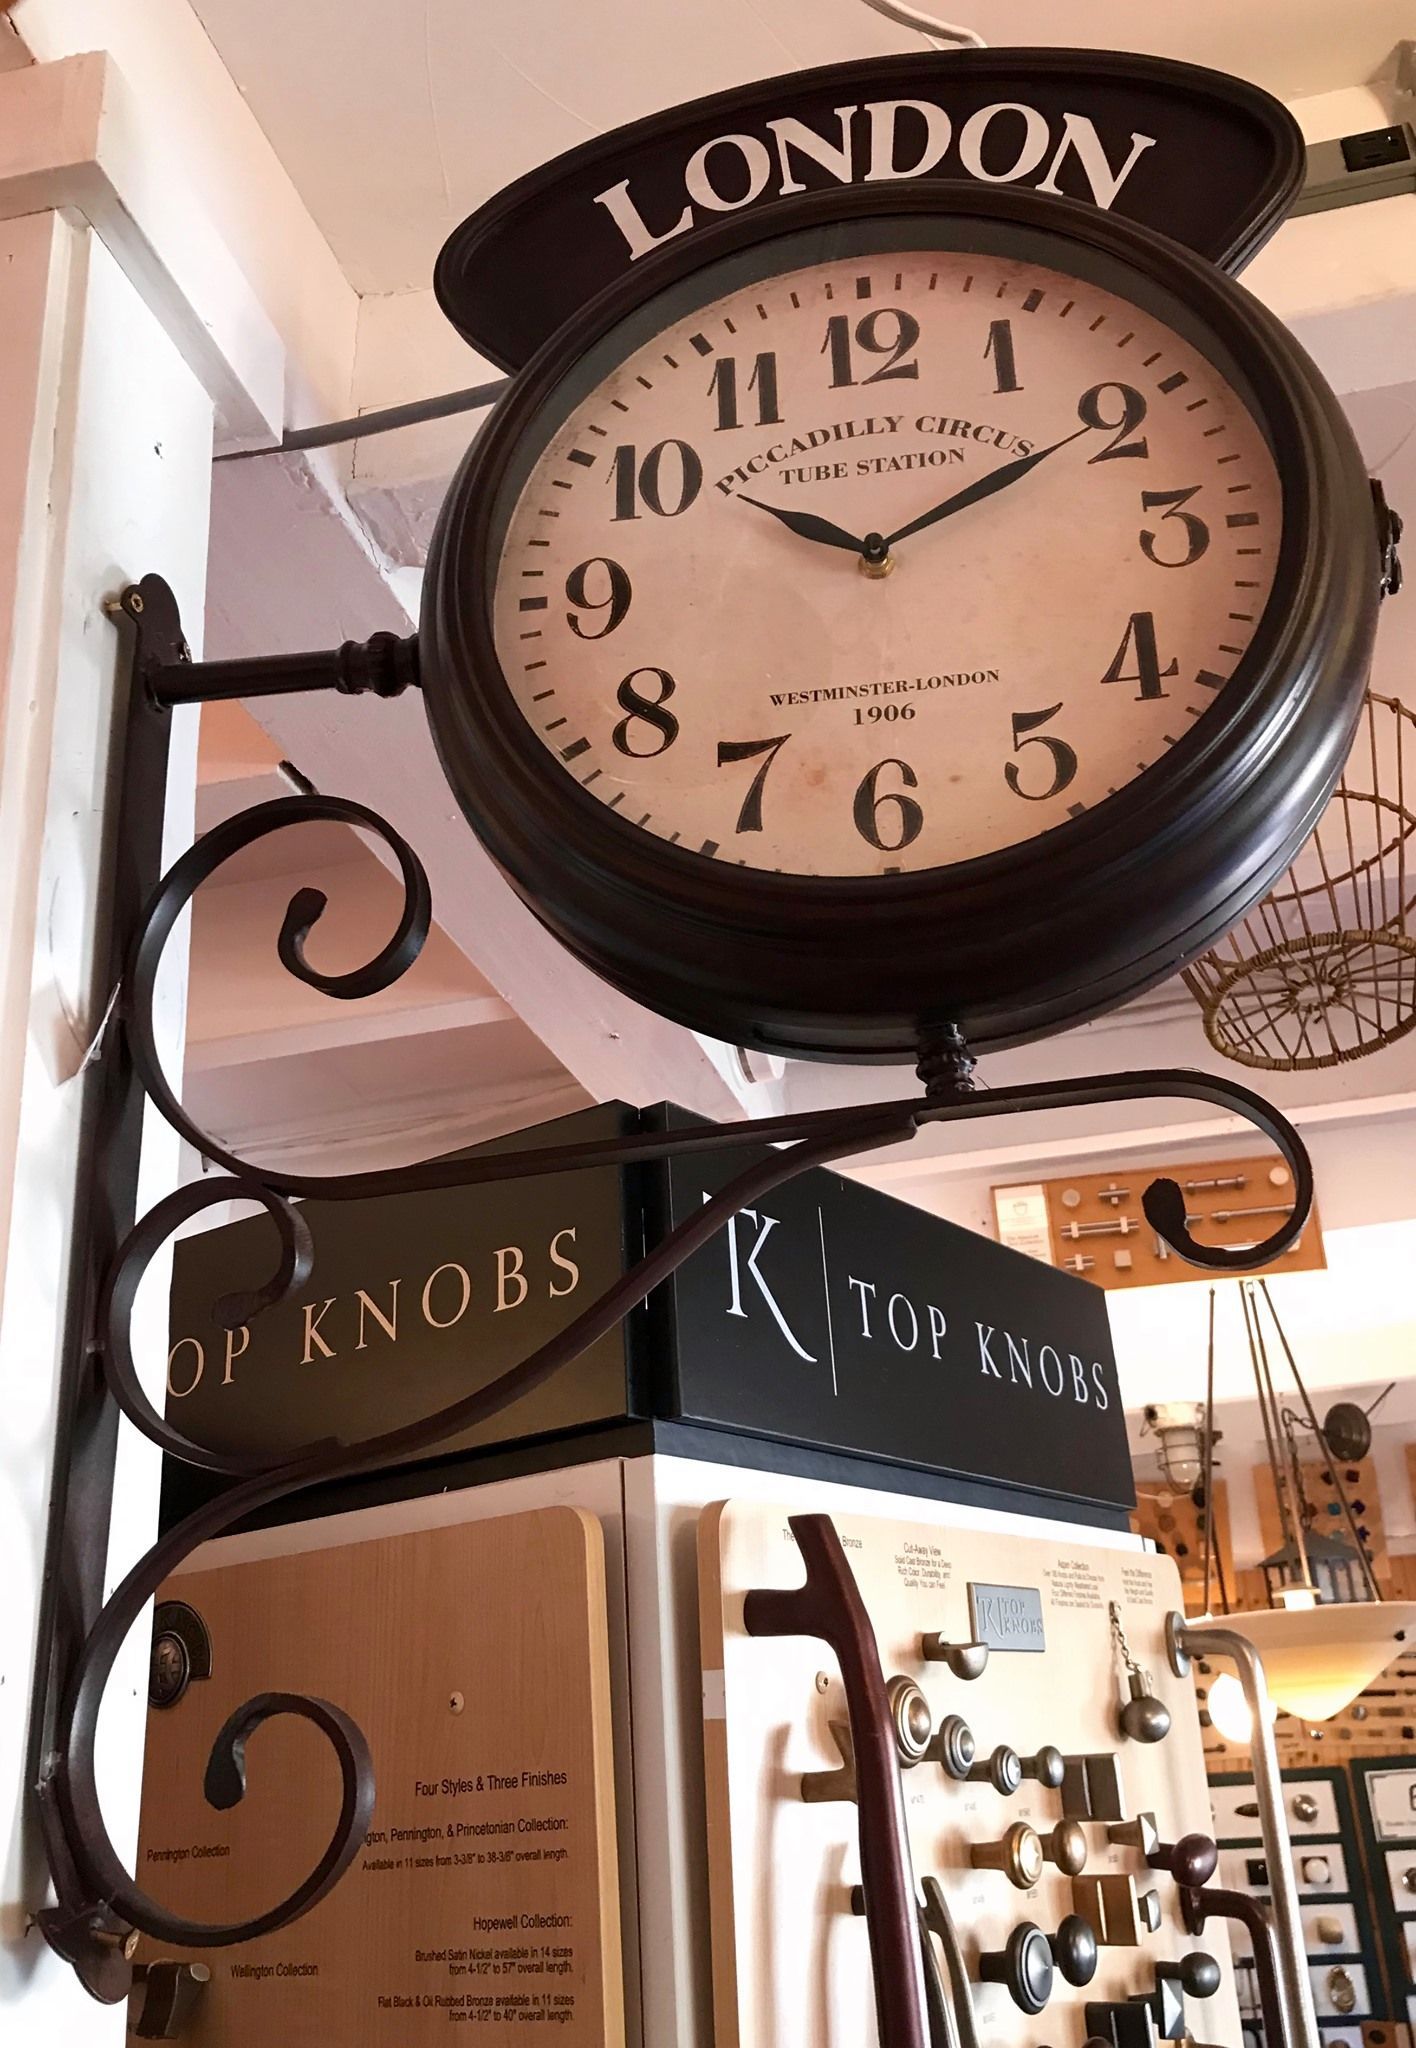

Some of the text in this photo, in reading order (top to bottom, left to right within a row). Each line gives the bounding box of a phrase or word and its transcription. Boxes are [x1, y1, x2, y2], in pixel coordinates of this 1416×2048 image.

[594, 99, 1156, 260] LONDON
[820, 307, 920, 389] 12
[984, 319, 1024, 394] 1
[707, 352, 785, 432] 11
[1077, 382, 1149, 465] 2
[606, 438, 703, 522] 10
[714, 415, 1036, 497] PICCADILLY CIRCUS
[779, 447, 966, 485] TUBE STATION
[1139, 485, 1210, 568] 3
[565, 557, 632, 640] 9
[769, 669, 1000, 707] WESTMINSTER-LONDON
[1100, 610, 1179, 702] 4
[612, 667, 680, 759] 8
[853, 703, 916, 726] 1906
[1005, 701, 1077, 801] 5
[717, 733, 792, 834] 7
[853, 758, 924, 851] 6
[300, 1227, 579, 1365] KNOBS
[848, 1275, 1109, 1410] TOP KNOBS
[415, 1771, 567, 1797] Four Styles & Three Finishes
[146, 1845, 230, 1863] Pennington Collection
[362, 1859, 394, 1871] Available
[396, 1859, 402, 1869] in
[415, 1857, 434, 1868] sizes
[436, 1855, 452, 1867] from
[478, 1853, 485, 1864] to
[516, 1849, 541, 1861] overall
[391, 1824, 444, 1843] Pennington,
[447, 1824, 454, 1837] &
[457, 1820, 515, 1837] Princetonian
[518, 1817, 568, 1833] Collection:
[415, 1946, 573, 1962] Brushed Satin Nickel available in 14 sizes
[473, 1913, 573, 1933] Hopewell Collection:
[231, 1962, 319, 1980] Wellington Collection
[435, 1995, 465, 2007] Rubbed
[466, 1995, 493, 2006] Bronze
[495, 1994, 530, 2006] available
[532, 1994, 540, 2005] in
[553, 1994, 574, 2005] sizes
[449, 1963, 467, 1975] from
[493, 1962, 501, 1973] to
[518, 1961, 544, 1973] overall
[546, 1961, 573, 1975] length.
[449, 2010, 467, 2022] from
[493, 2009, 501, 2020] to
[518, 2009, 545, 2021] overall
